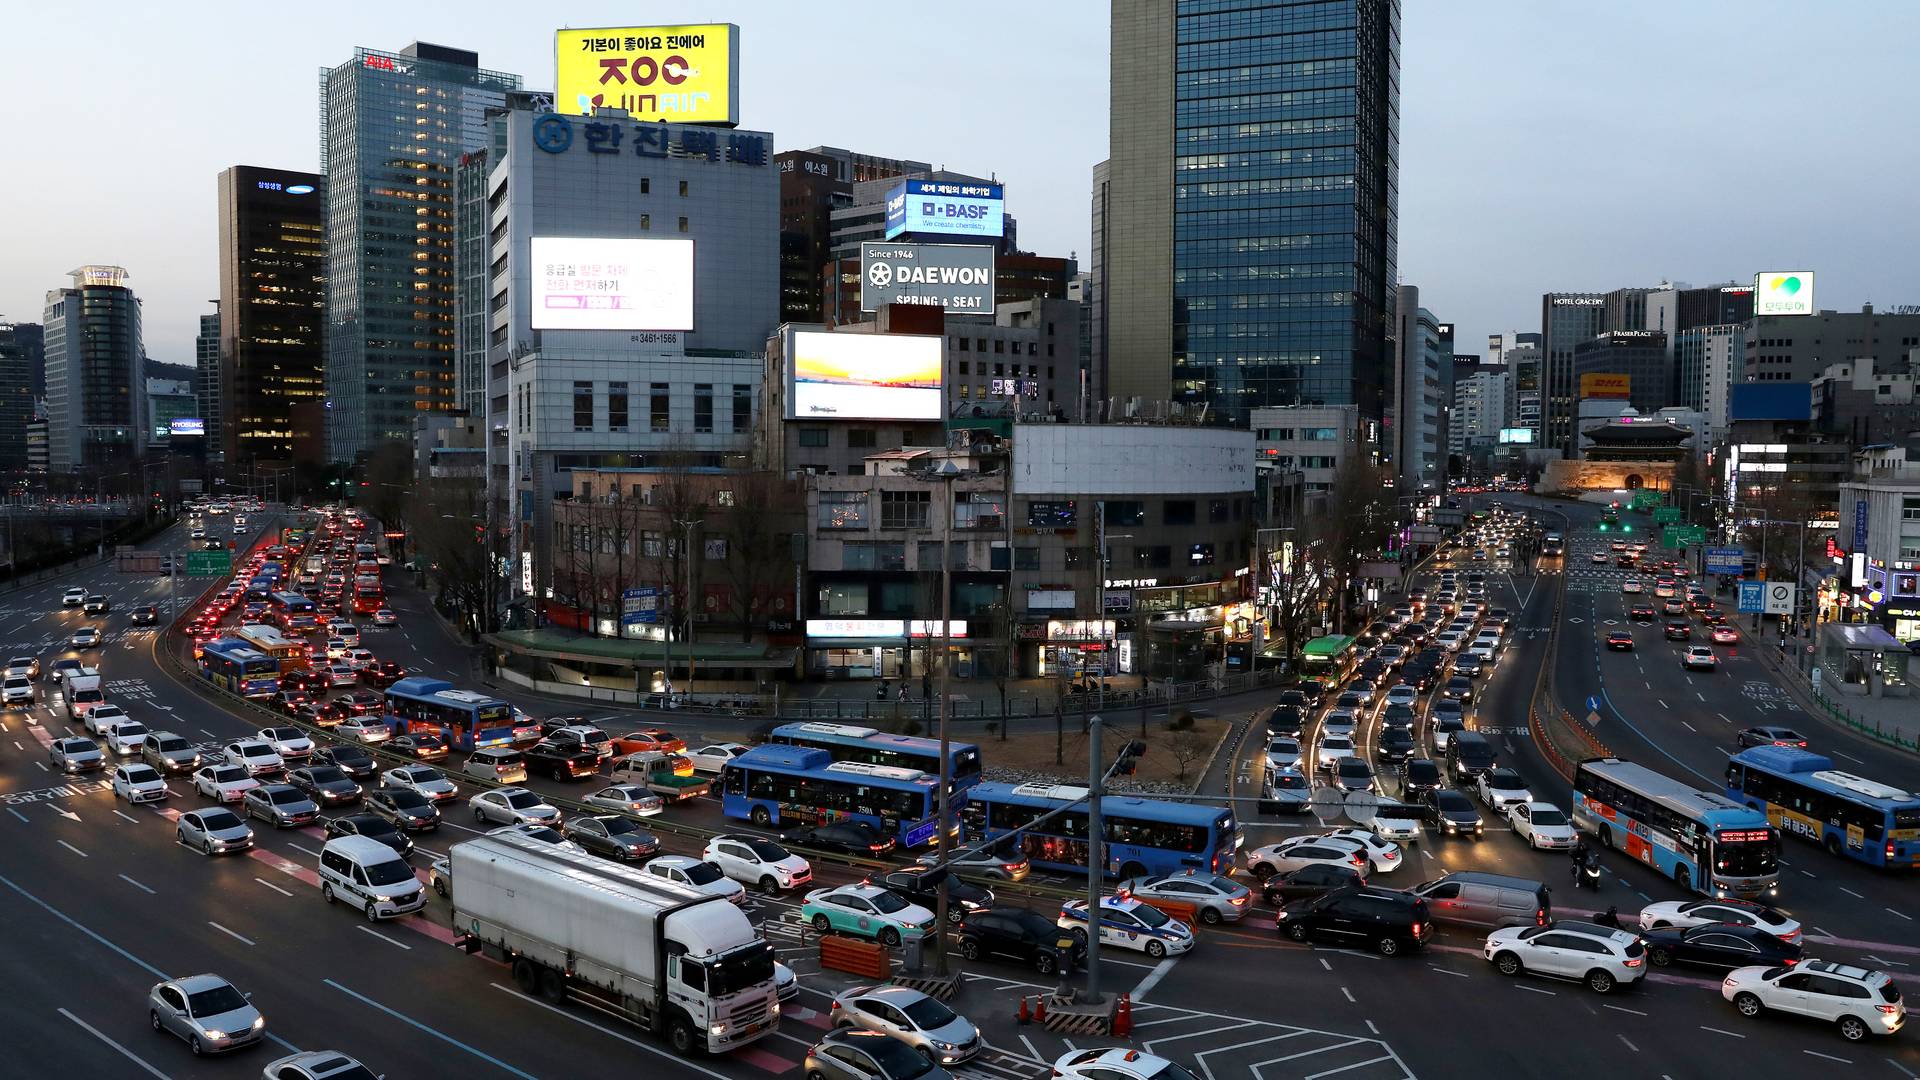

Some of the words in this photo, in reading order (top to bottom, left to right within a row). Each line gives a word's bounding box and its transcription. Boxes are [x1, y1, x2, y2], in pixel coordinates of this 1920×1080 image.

[582, 38, 620, 51] 기본이
[624, 36, 662, 51] 좋아요
[666, 34, 705, 49] 진에어
[366, 55, 394, 72] AIA
[584, 121, 765, 166] 한진택배
[776, 159, 794, 173] 스원
[804, 160, 828, 177] 에스원
[945, 203, 989, 219] BASF
[955, 222, 986, 231] chemistry
[869, 250, 892, 259] Since
[893, 250, 914, 259] 1946
[546, 264, 576, 276] 응급실
[896, 266, 989, 285] DAEWON
[896, 295, 938, 307] SPRING
[953, 296, 982, 308] SEAT
[1765, 301, 1805, 312] 모두투어
[639, 334, 677, 344] 3461-1566
[1792, 819, 1817, 840] 해커스
